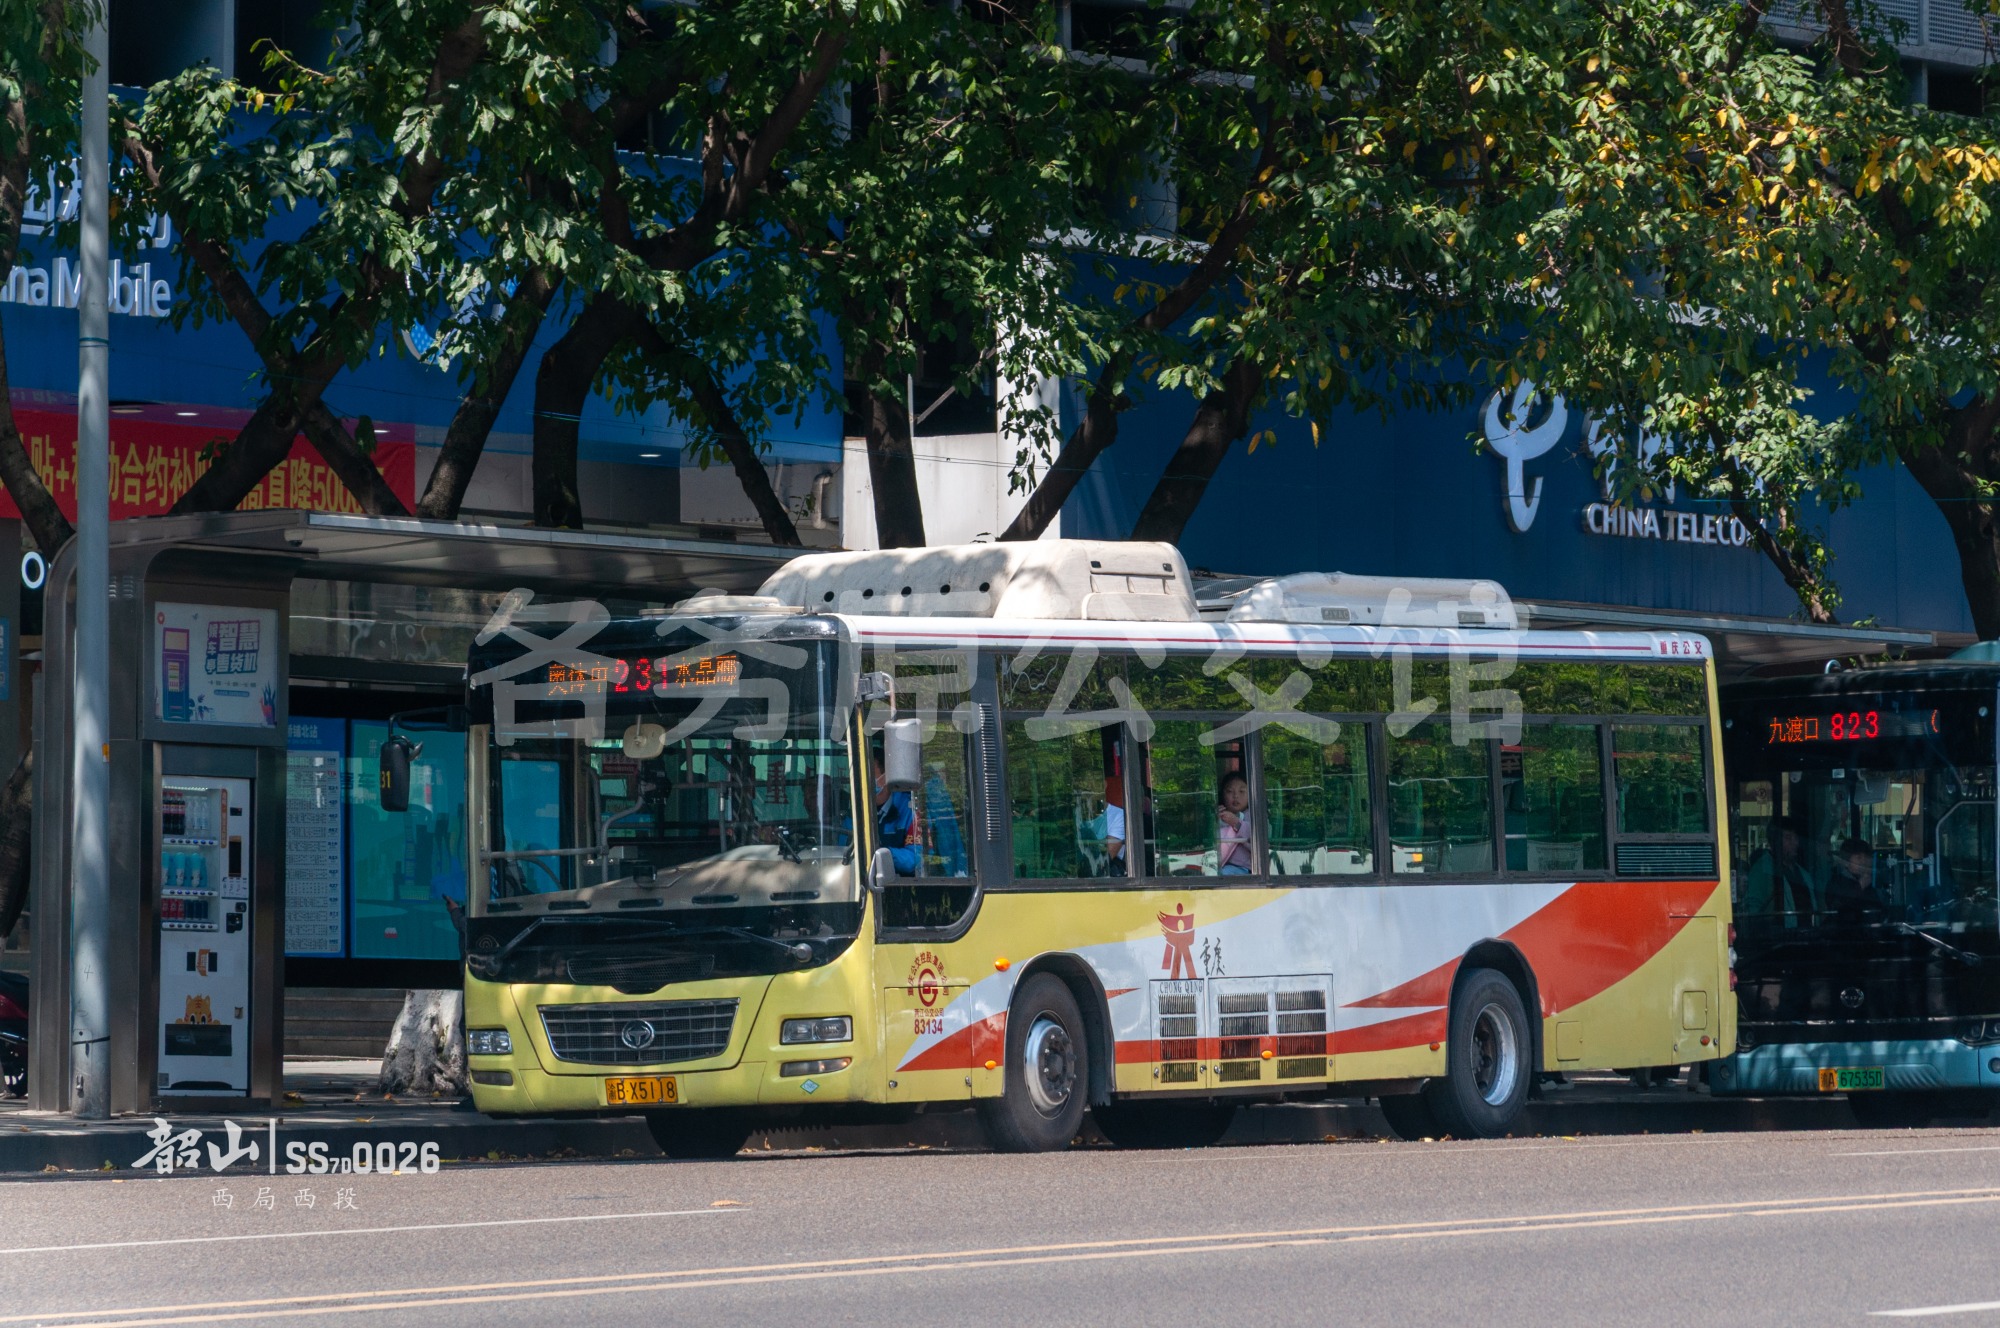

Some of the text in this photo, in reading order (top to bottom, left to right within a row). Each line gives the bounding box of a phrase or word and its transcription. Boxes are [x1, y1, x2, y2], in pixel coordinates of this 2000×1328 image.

[53, 256, 172, 318] Mbile
[1584, 502, 1766, 548] CHINA TELECO
[219, 620, 260, 651] 智慧
[1660, 640, 1702, 655] 重庆公交
[217, 652, 257, 673] 售货机
[614, 657, 668, 692] 231
[1769, 716, 1820, 744] 九渡口
[1831, 710, 1879, 740] 823
[1160, 980, 1203, 993] CHONG QING
[914, 1018, 943, 1035] 83134
